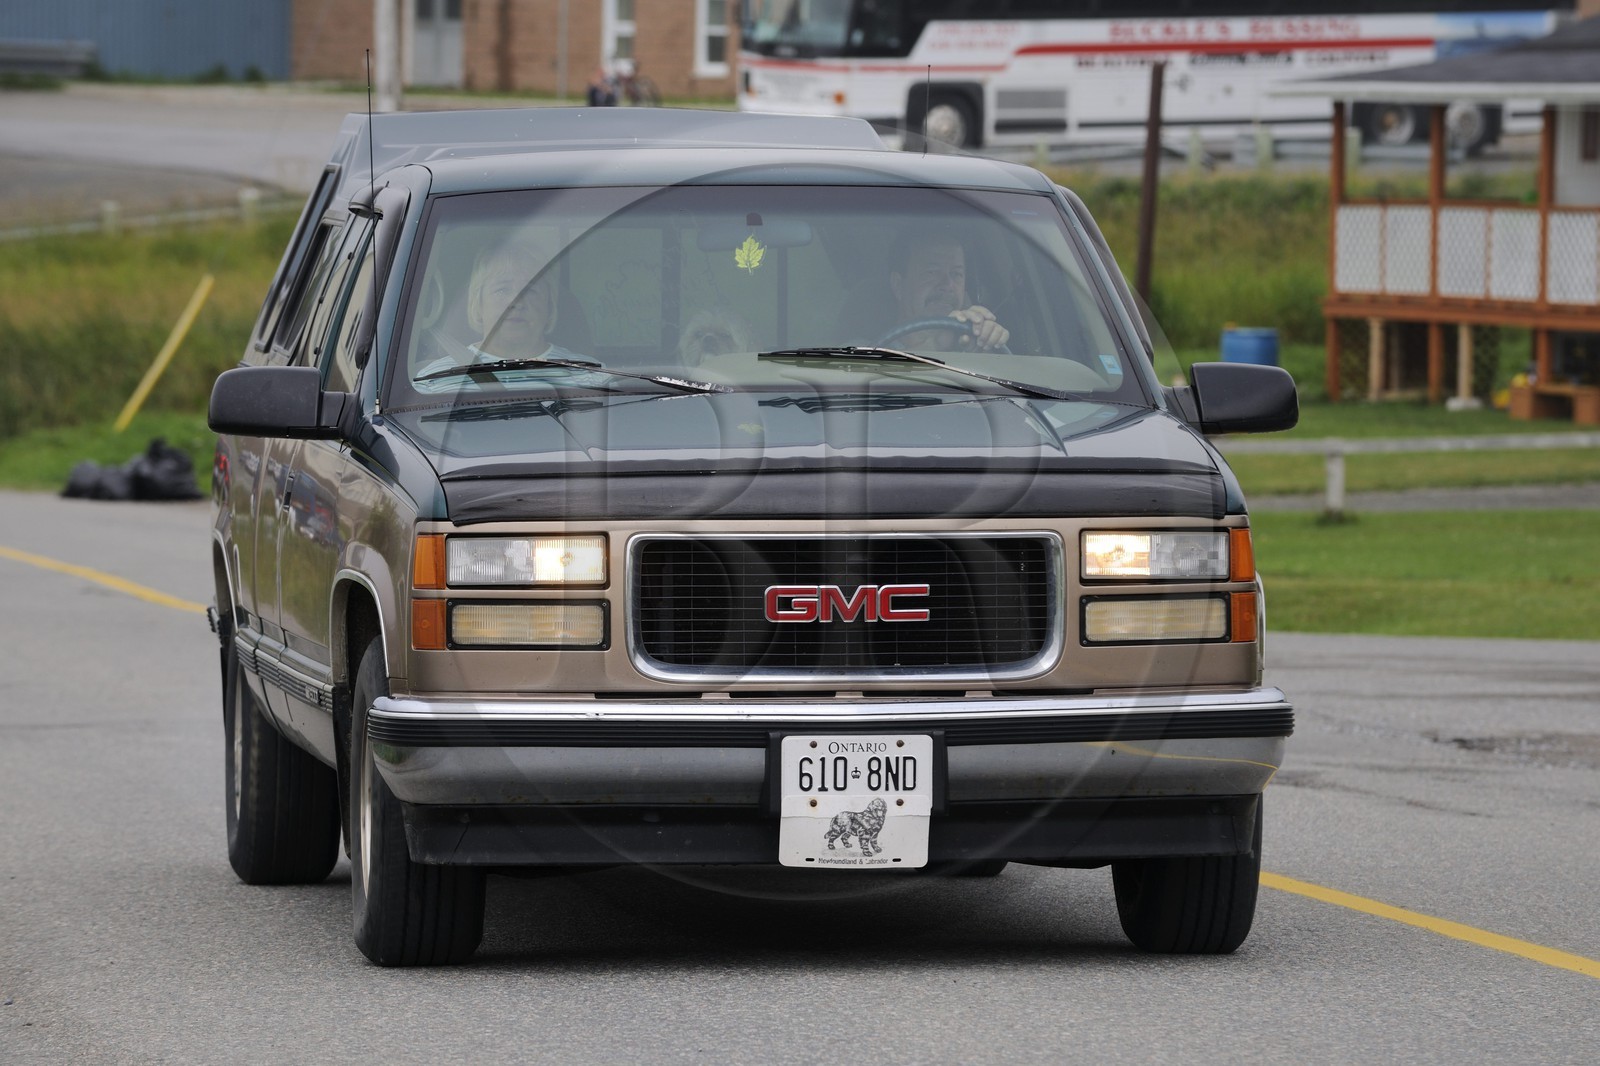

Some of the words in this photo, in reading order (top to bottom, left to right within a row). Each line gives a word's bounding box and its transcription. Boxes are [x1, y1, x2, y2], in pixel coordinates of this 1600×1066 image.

[765, 584, 930, 623] GMC
[799, 756, 848, 792] 610
[867, 756, 917, 791] 8ND
[818, 857, 858, 865] Newfoundland
